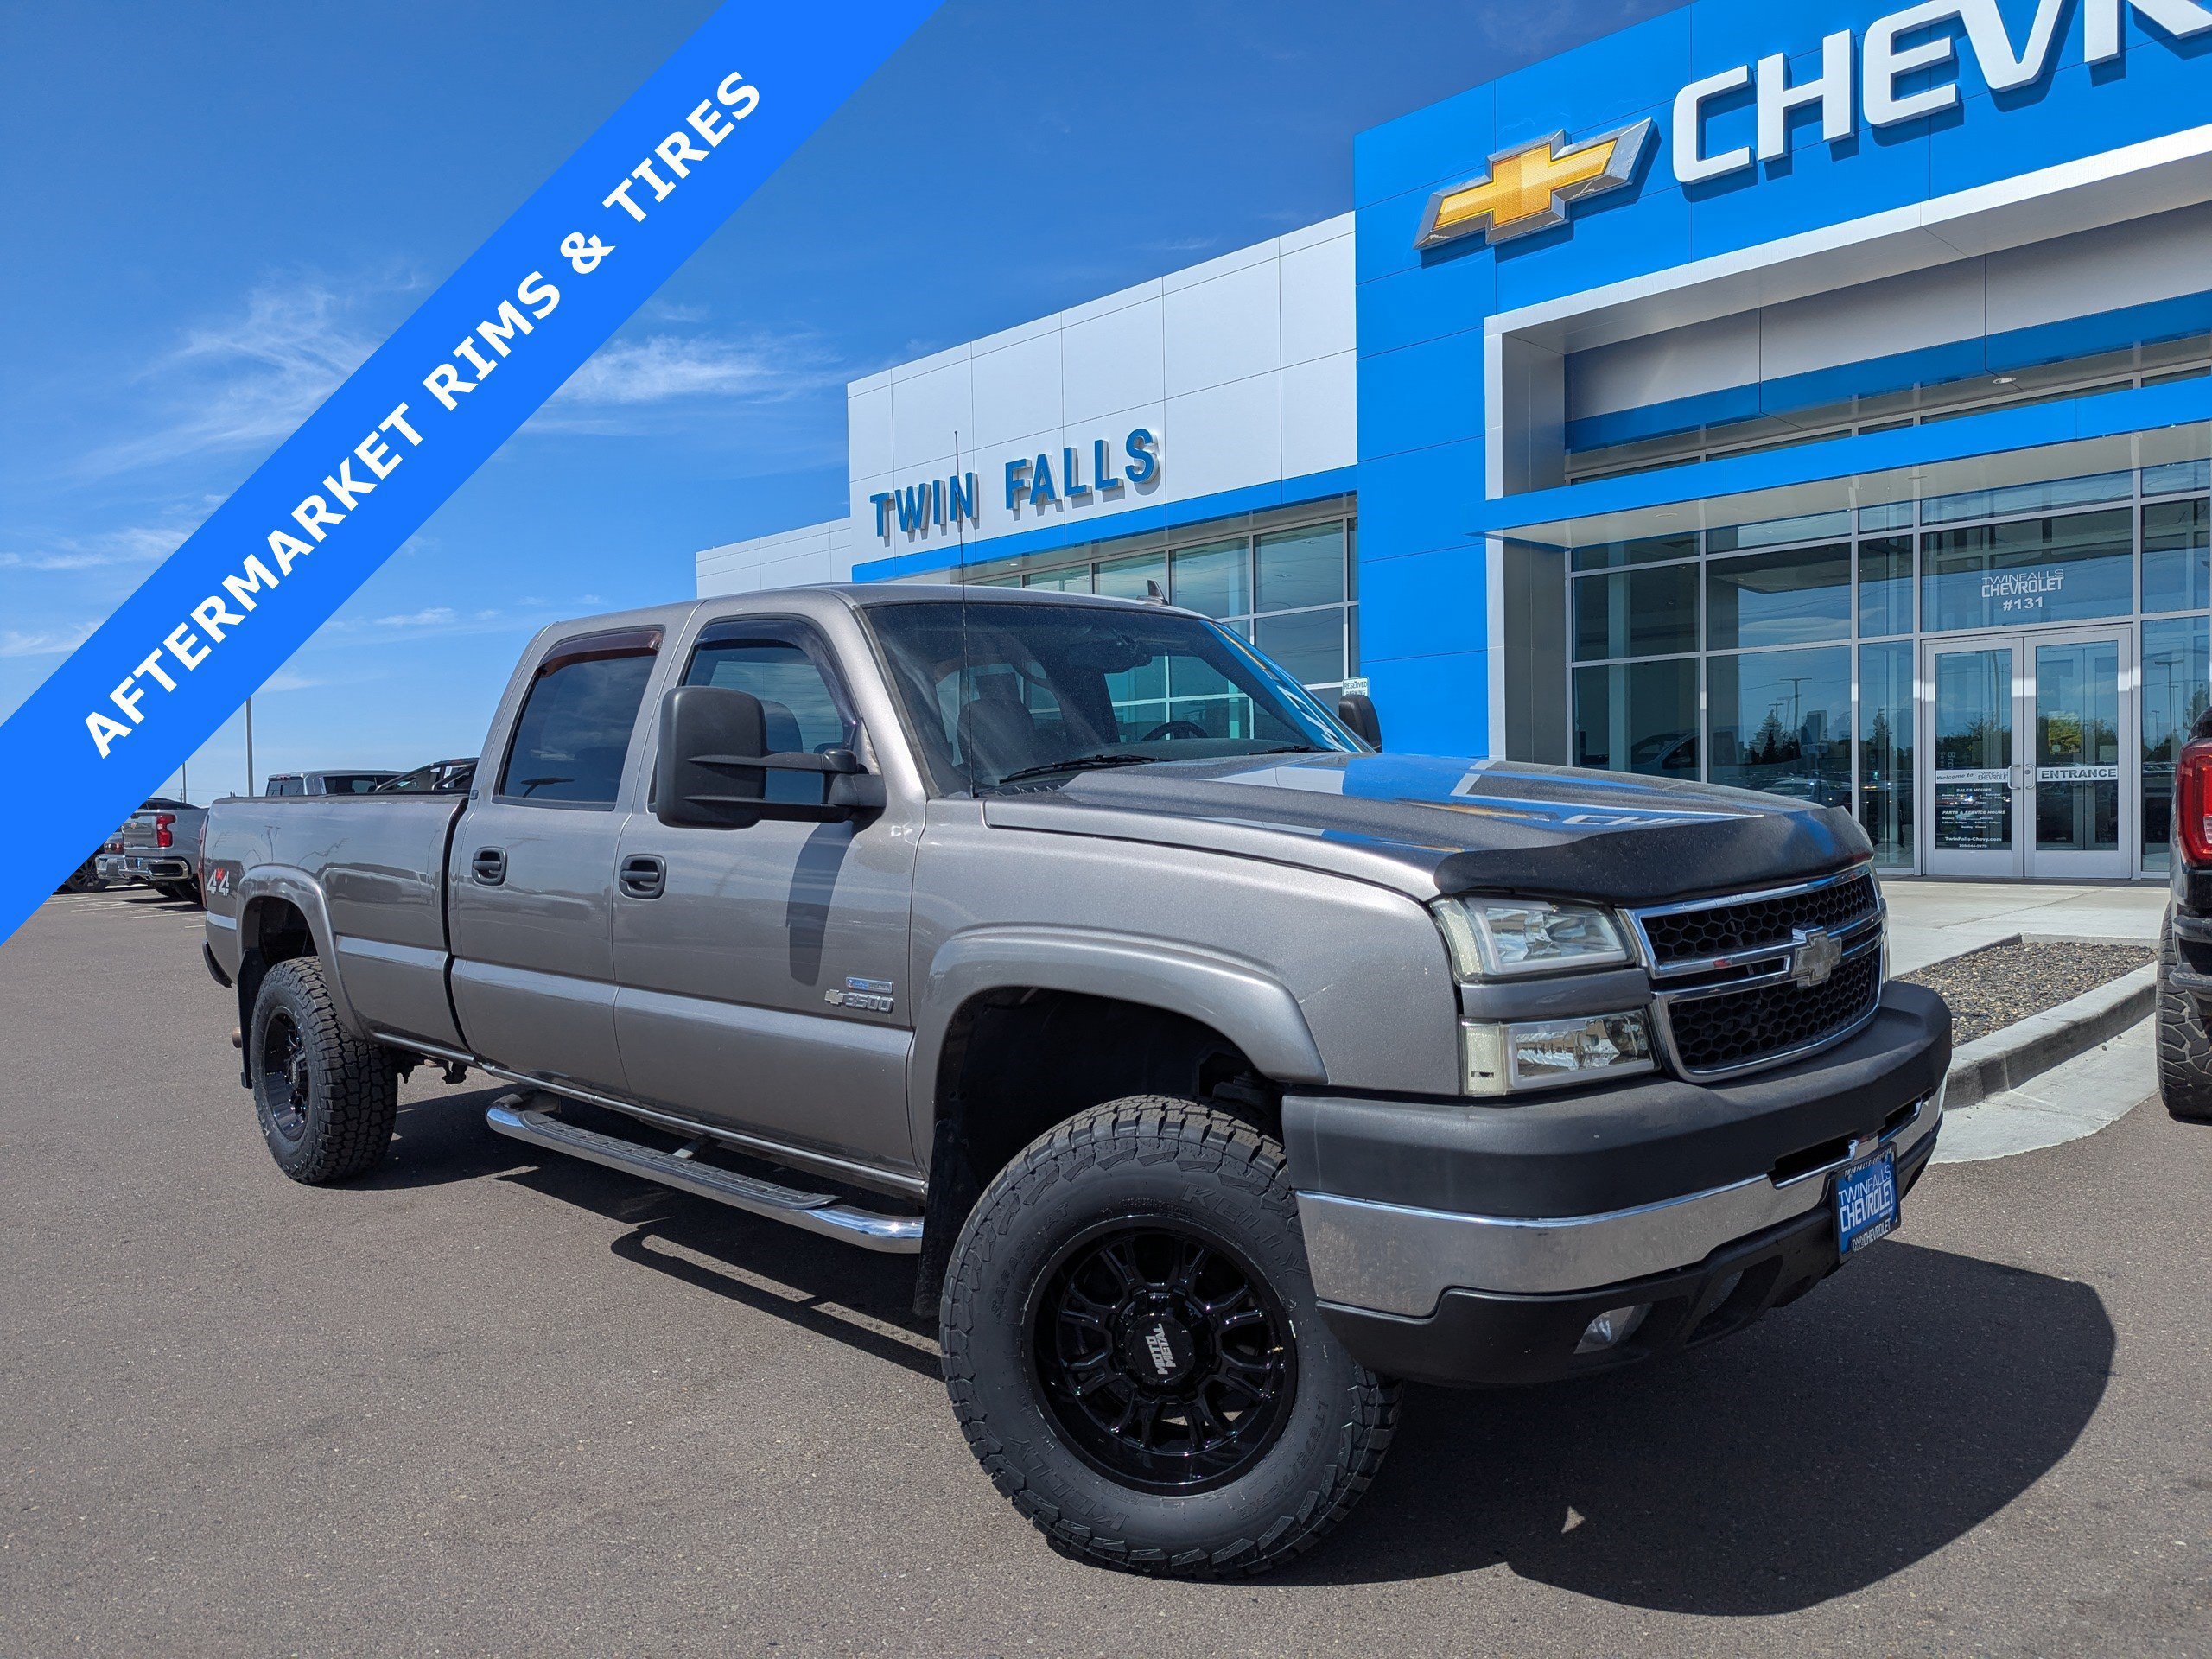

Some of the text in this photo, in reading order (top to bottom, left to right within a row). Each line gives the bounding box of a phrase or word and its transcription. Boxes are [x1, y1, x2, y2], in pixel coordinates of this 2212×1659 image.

[869, 428, 1160, 537] TWIN FALLS
[1981, 577, 2064, 598] CHEVROLET
[2003, 596, 2043, 612] #131
[2041, 768, 2117, 779] ENTRANCE
[845, 992, 893, 1013] 3500
[1838, 1165, 1891, 1206] TWINFALLS
[1839, 1179, 1892, 1233] CHEVROLET
[1145, 1335, 1169, 1375] MOTO
[1153, 1323, 1176, 1368] METAL
